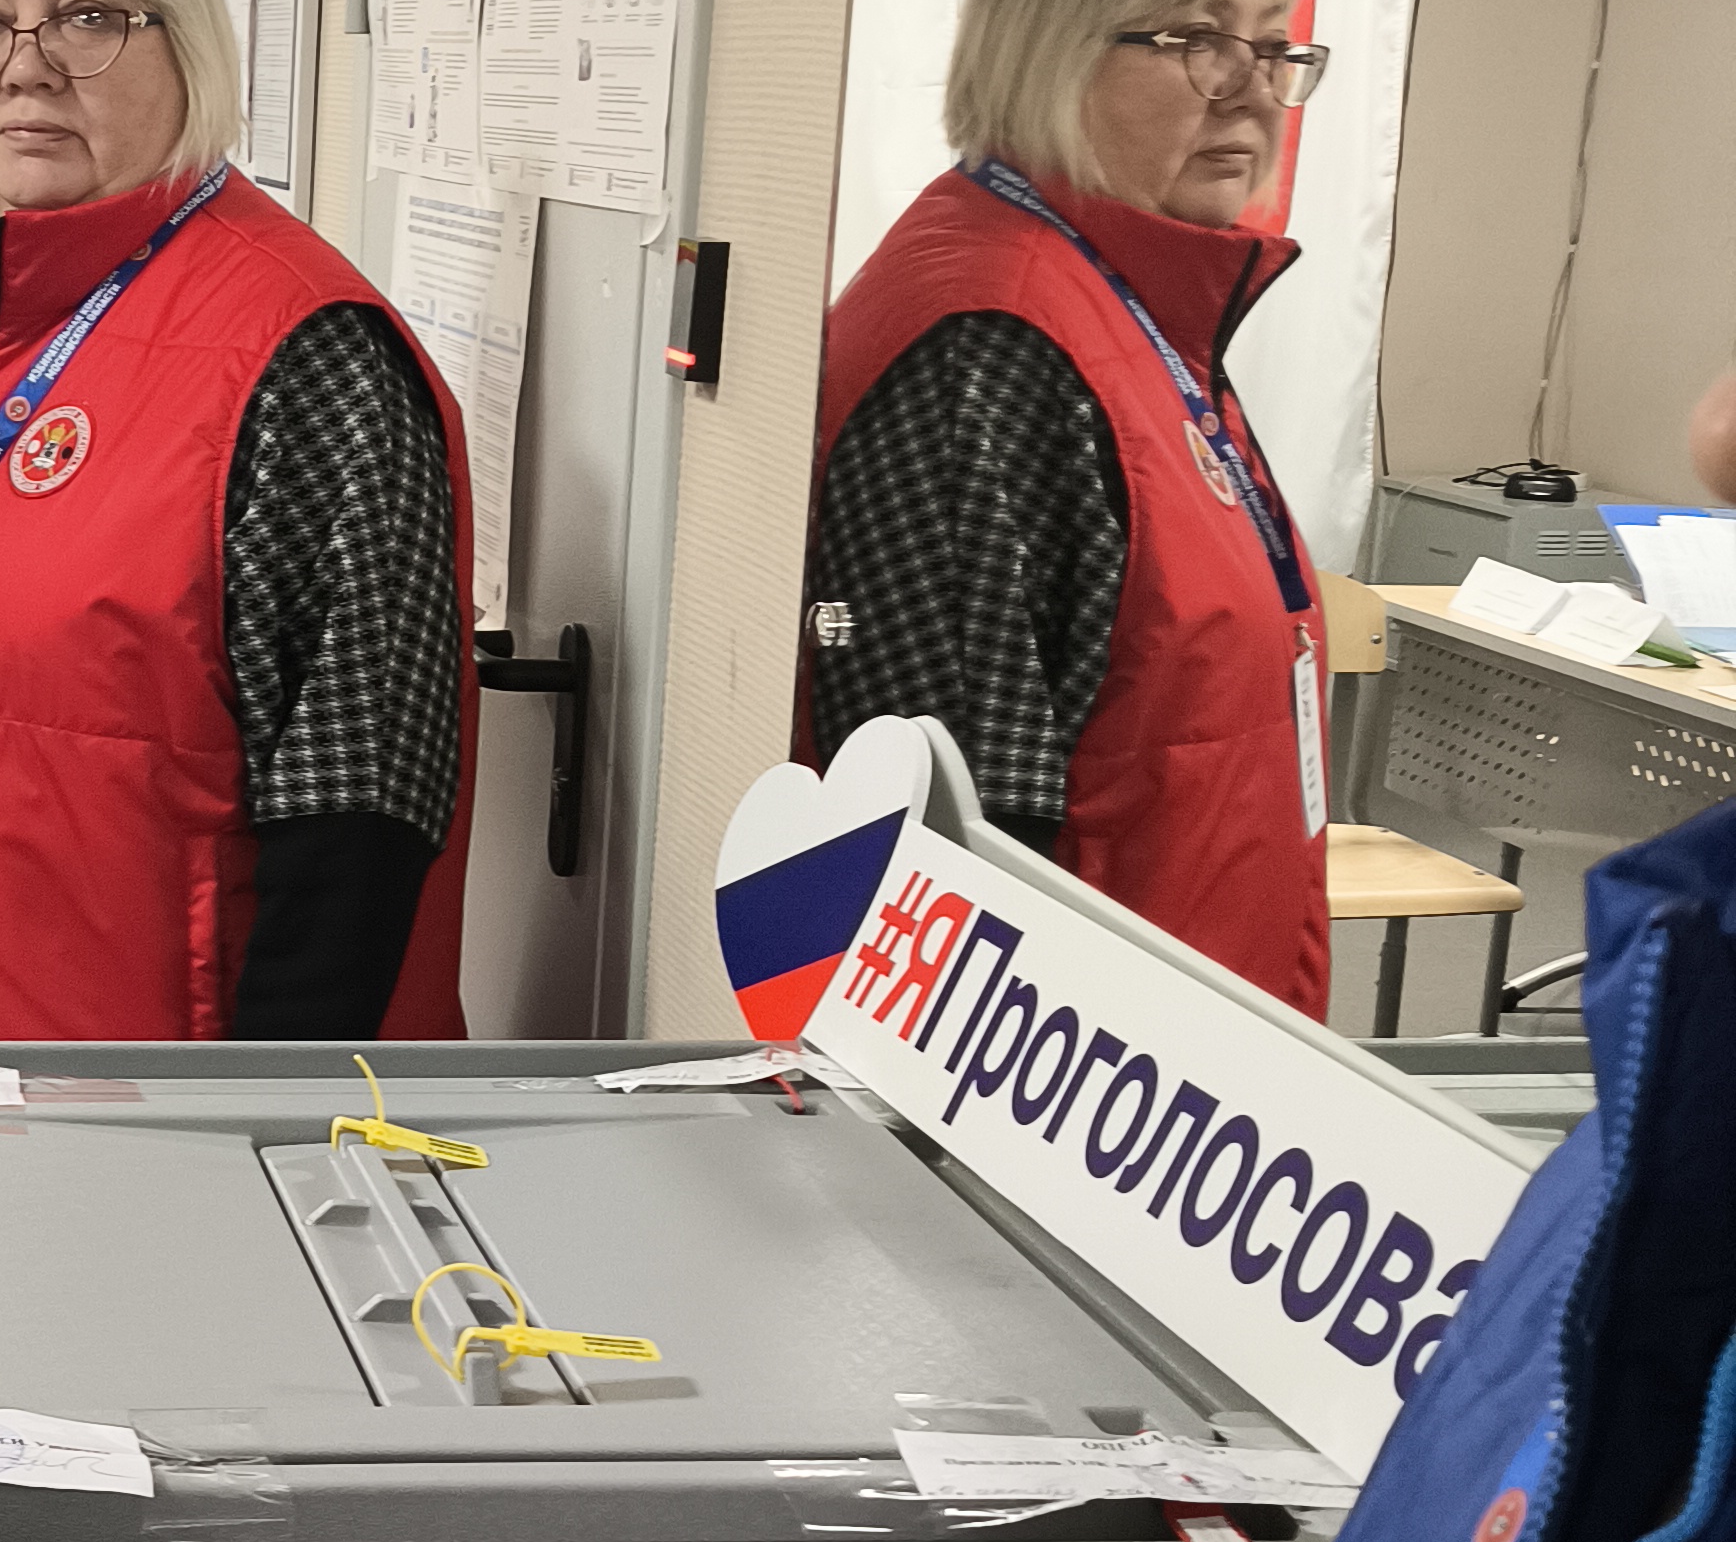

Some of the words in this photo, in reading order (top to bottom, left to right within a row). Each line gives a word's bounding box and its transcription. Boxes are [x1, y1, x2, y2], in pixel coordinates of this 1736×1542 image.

[26, 314, 85, 383] ИЗБИРАТЕЛЬНАЯ
[43, 319, 92, 381] МОСКОВСКОЙ
[86, 283, 122, 322] ОБЛАСТИ
